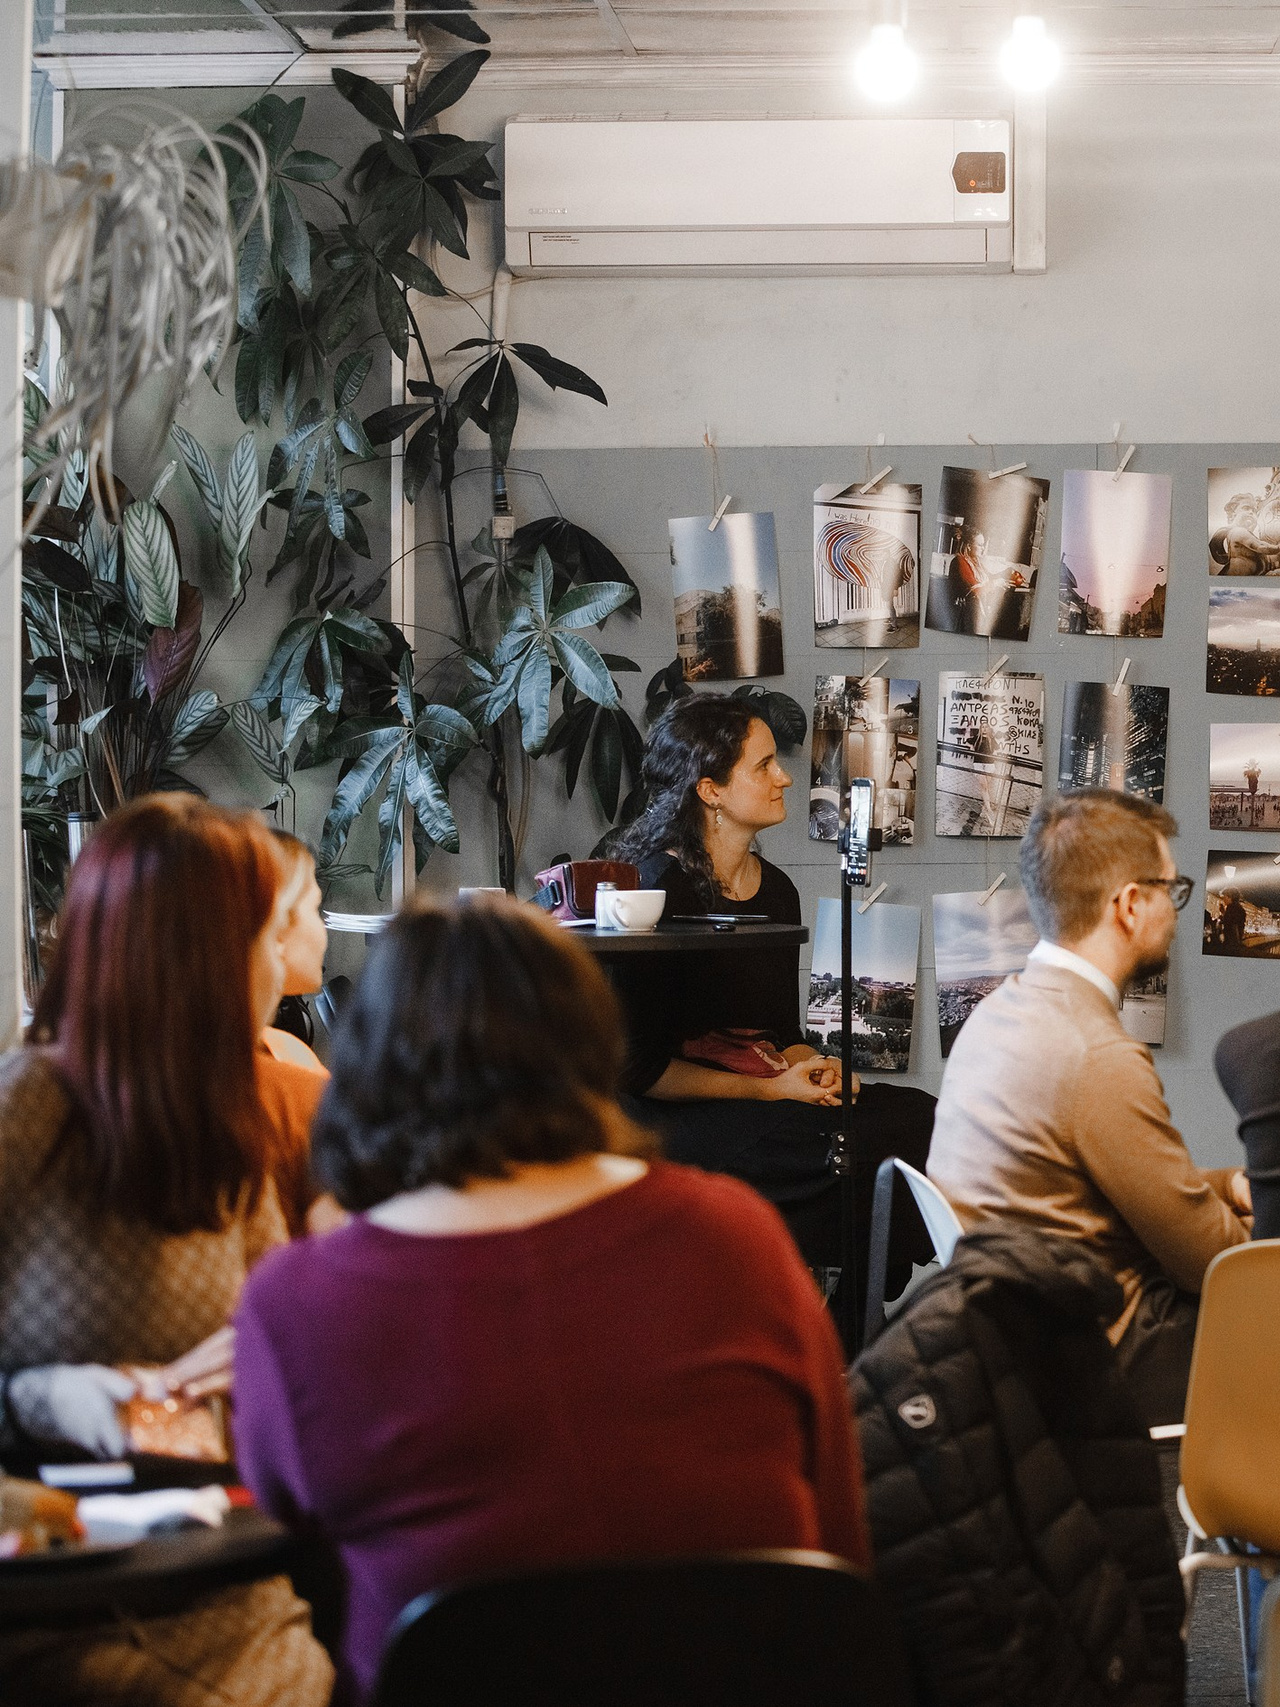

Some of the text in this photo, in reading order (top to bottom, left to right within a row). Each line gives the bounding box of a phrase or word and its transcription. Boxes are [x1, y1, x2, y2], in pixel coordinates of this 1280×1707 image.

[827, 507, 832, 517] I
[834, 512, 848, 521] was
[849, 513, 871, 525] Here!
[907, 725, 914, 735] 3
[815, 776, 822, 786] 4
